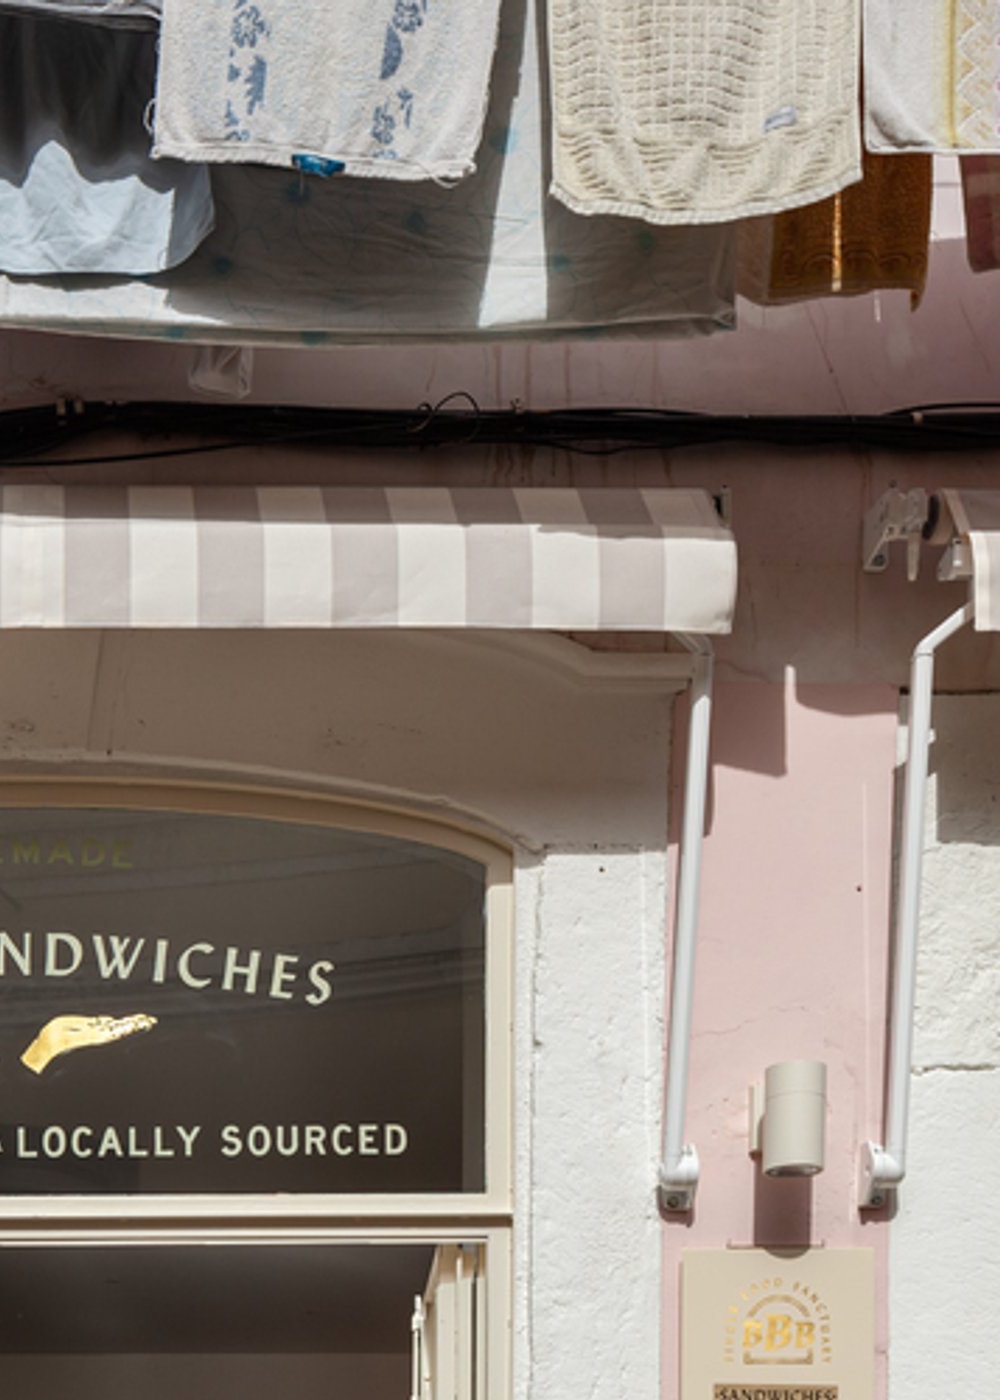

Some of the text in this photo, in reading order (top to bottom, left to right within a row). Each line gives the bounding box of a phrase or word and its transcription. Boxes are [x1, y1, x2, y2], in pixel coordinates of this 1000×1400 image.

[17, 1126, 201, 1158] LOCALLY
[220, 1124, 408, 1157] SOURCED
[742, 1314, 815, 1351] BBB
